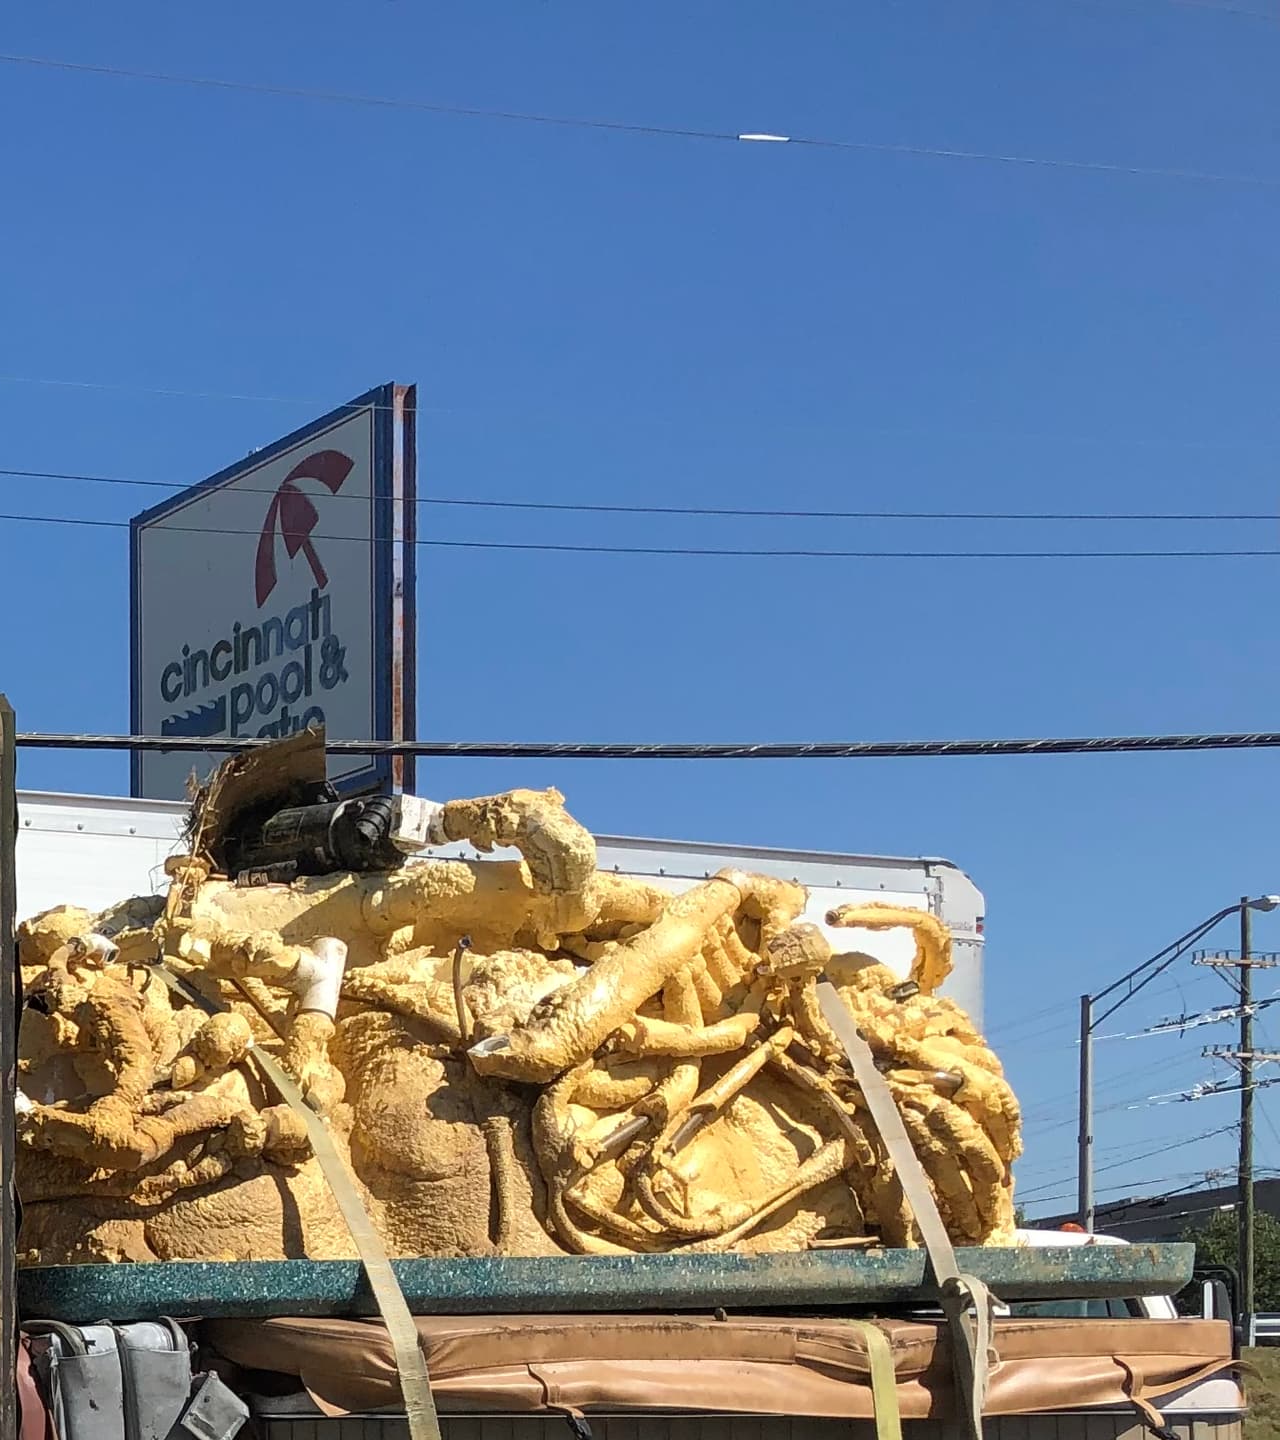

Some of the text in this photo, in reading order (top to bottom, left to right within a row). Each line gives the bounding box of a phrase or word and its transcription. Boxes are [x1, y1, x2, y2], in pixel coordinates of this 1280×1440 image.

[161, 587, 331, 703] cincinnati
[231, 643, 313, 738] pool
[319, 633, 350, 690] &
